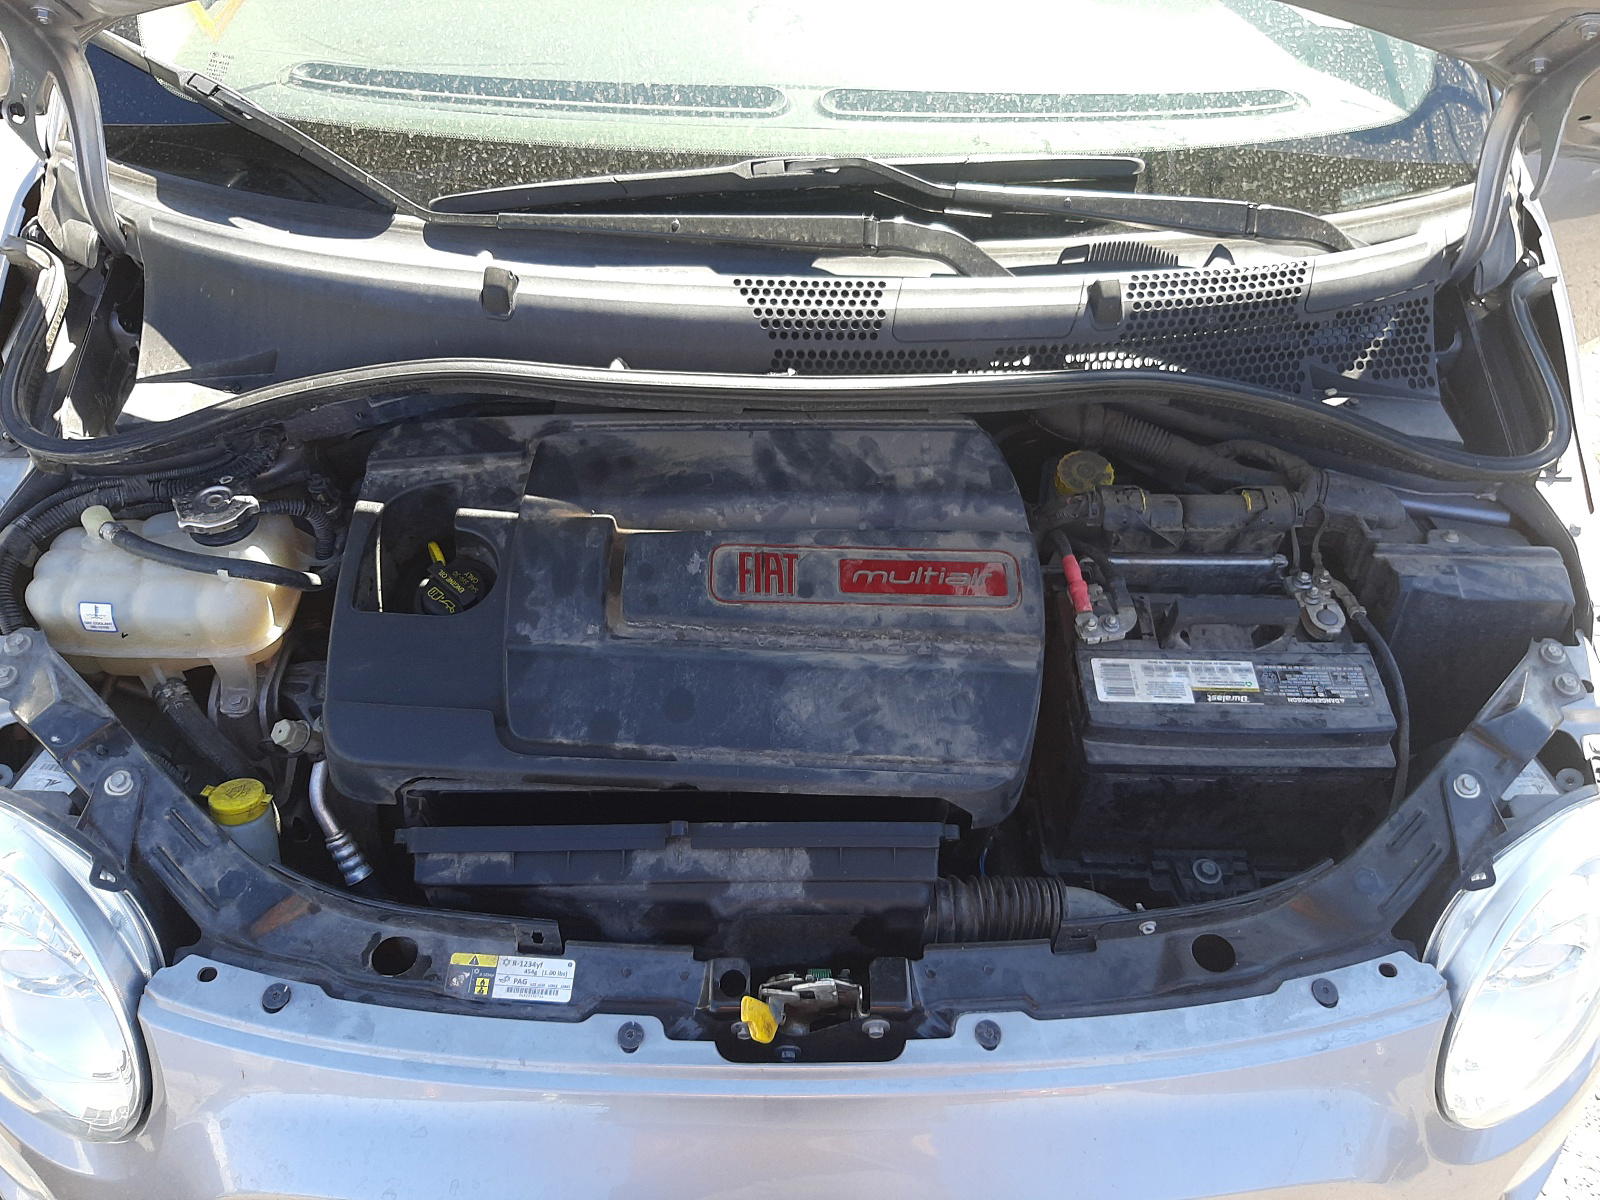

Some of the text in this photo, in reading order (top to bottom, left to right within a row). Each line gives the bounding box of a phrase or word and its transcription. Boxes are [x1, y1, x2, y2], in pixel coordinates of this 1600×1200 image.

[737, 552, 994, 596] FIAT multiair
[1207, 693, 1250, 703] Duralast
[512, 960, 544, 970] R-1234yf
